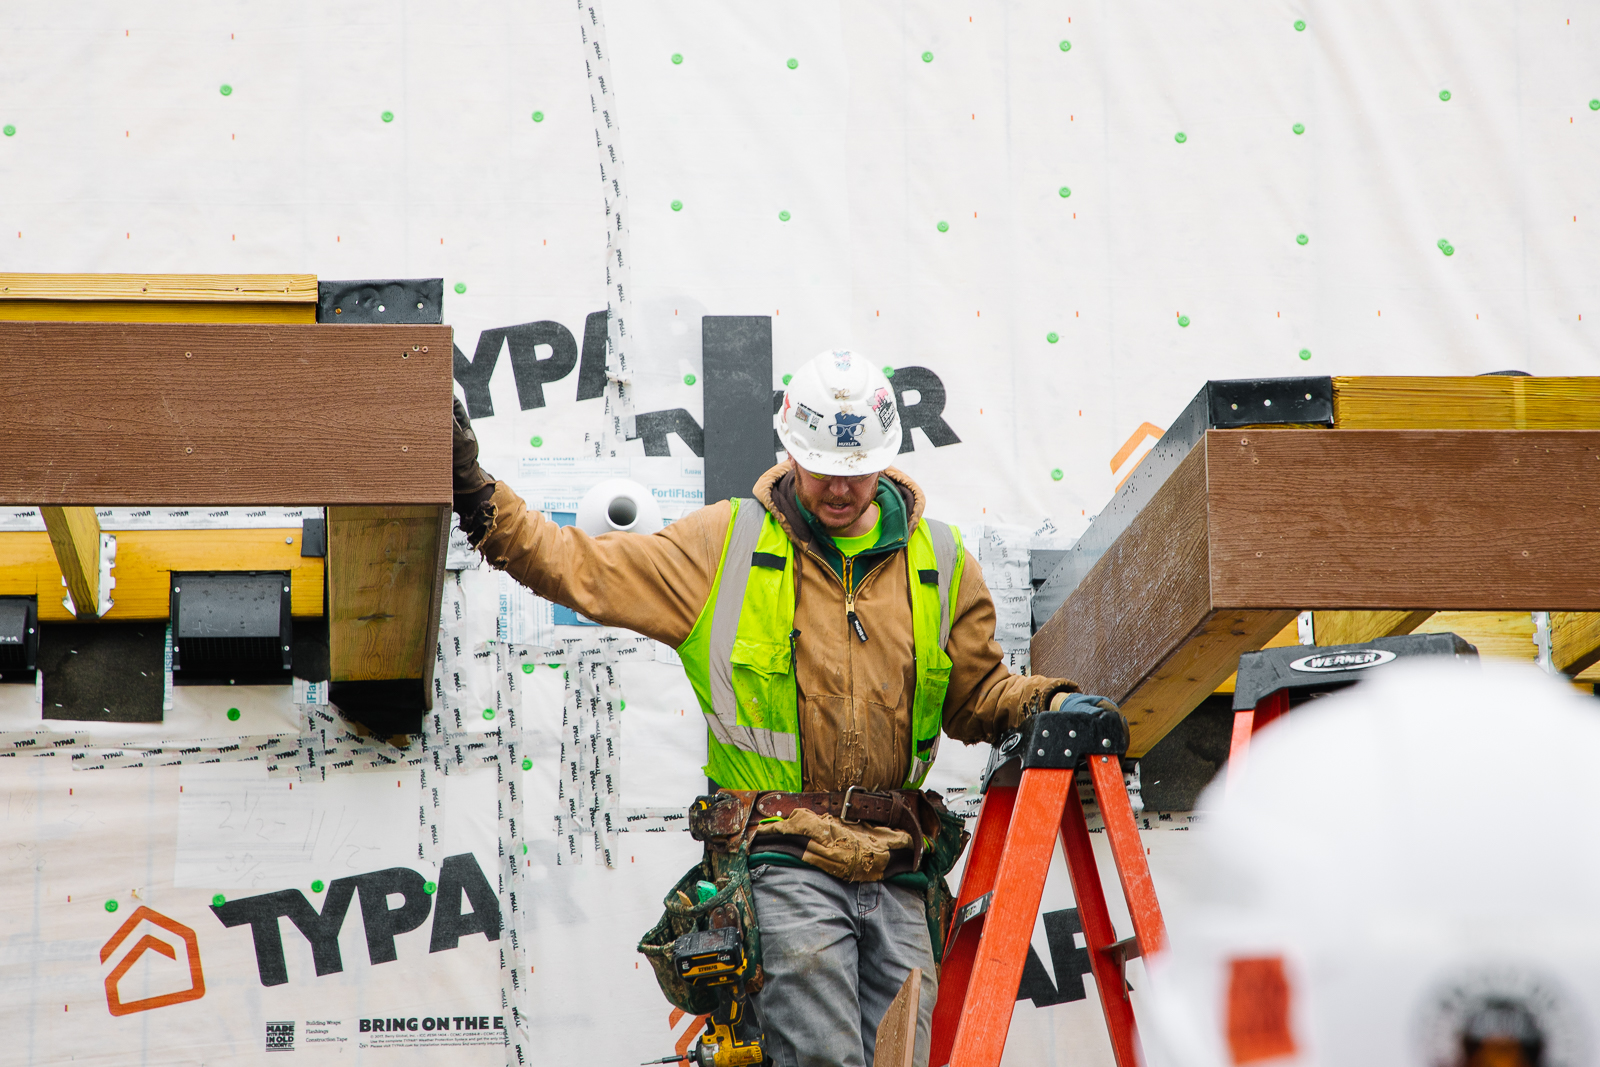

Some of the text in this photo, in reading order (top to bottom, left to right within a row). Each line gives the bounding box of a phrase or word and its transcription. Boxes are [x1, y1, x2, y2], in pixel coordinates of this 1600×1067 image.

[617, 283, 625, 302] TYPAR
[619, 352, 627, 372] TYPAR
[651, 488, 703, 498] FortiFlash
[13, 510, 36, 519] TYPAR
[1034, 522, 1055, 537] Tyvek
[454, 601, 462, 621] TYPAR
[544, 647, 637, 658] TYPAR TYPAR TYPAR
[1311, 653, 1376, 668] WERNER
[507, 672, 515, 692] TYPAR
[606, 665, 614, 686] TYPAR
[315, 710, 334, 723] TYPAR
[454, 708, 462, 728] TYPAR
[508, 708, 516, 728] TYPAR
[14, 738, 75, 748] TYPAR TYPAR
[345, 731, 365, 745] TYPAR
[606, 738, 614, 758] TYPAR
[102, 751, 124, 760] TYPAR
[141, 748, 162, 758] TYPAR
[179, 746, 201, 756] TYPAR
[218, 744, 239, 754] TYPAR
[307, 747, 315, 768] TYPAR
[433, 751, 441, 771] TYPAR
[455, 745, 463, 766] TYPAR
[508, 744, 516, 765] TYPAR
[332, 760, 354, 769] TYPAR
[509, 781, 517, 802] TYPAR
[605, 812, 613, 833] TYPAR
[627, 813, 685, 822] TYPAR TYPAR
[509, 818, 517, 839] TYPAR
[567, 835, 576, 855] TYPAR
[509, 855, 517, 875] TYPAR
[510, 892, 518, 913] TYPAR
[510, 929, 518, 951] TYPAR
[511, 969, 519, 991] TYPAR
[359, 1017, 418, 1032] BRING
[422, 1017, 450, 1031] ON
[453, 1017, 489, 1030] THE
[512, 1006, 521, 1028] TYPAR
[516, 1044, 525, 1065] TYPAR
